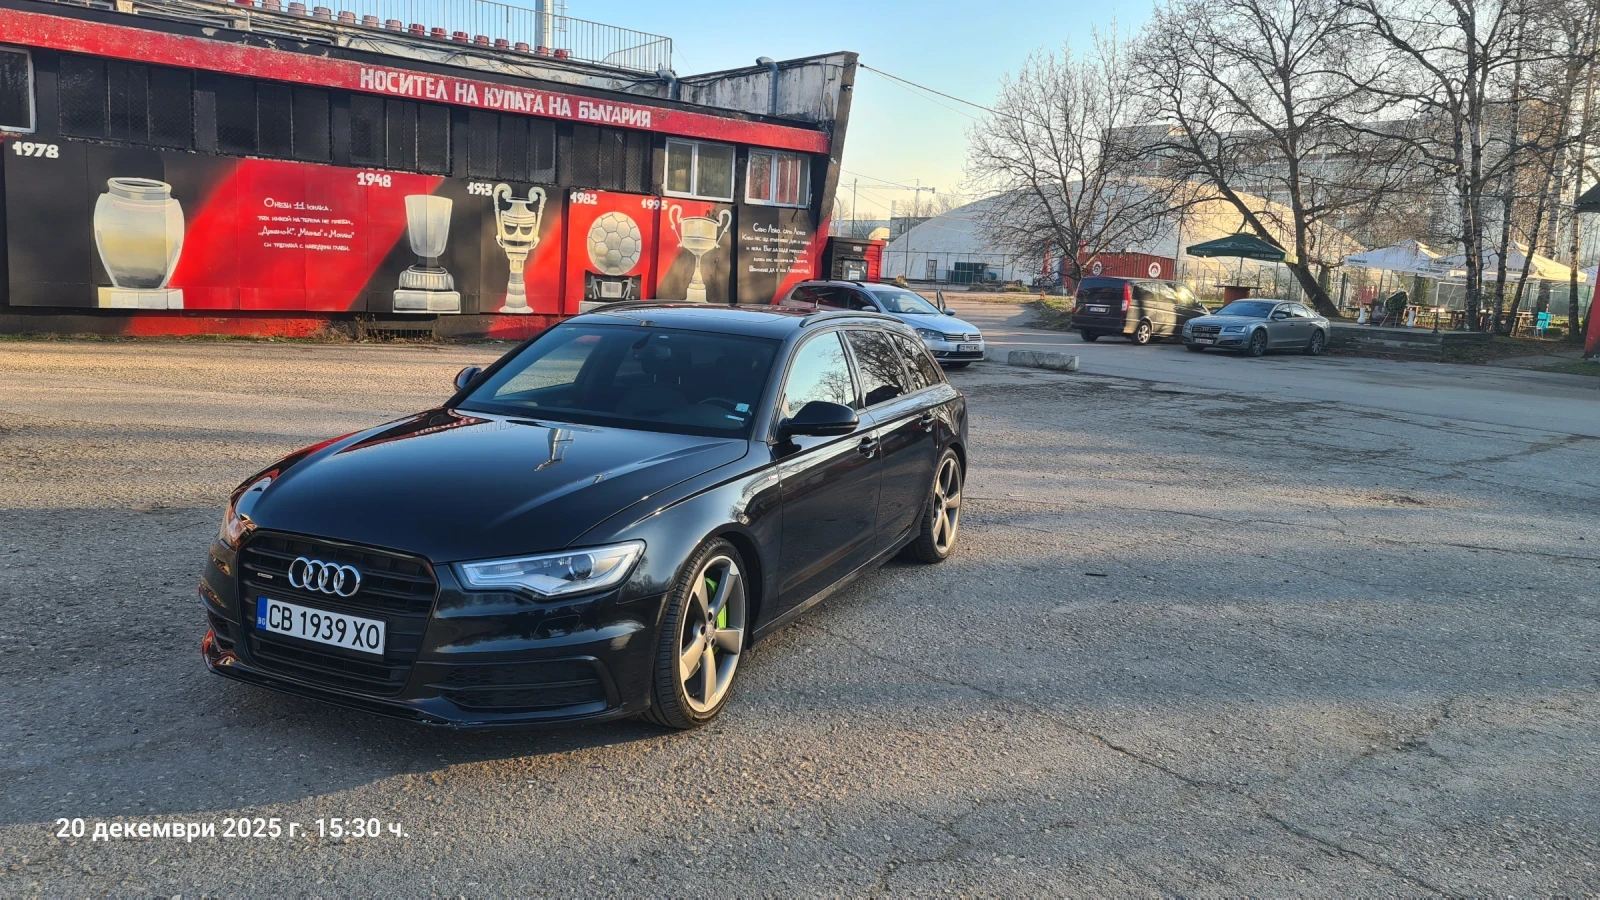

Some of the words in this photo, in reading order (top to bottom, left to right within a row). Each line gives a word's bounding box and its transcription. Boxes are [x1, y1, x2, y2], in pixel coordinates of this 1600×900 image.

[360, 67, 448, 100] НОСИТЕЛ
[455, 82, 478, 105] НА
[484, 87, 545, 114] КУПАТА
[549, 95, 571, 117] НА
[578, 101, 651, 128] БЪЛГАРИЯ
[12, 141, 59, 158] 1978
[357, 172, 391, 187] 1948
[570, 191, 597, 205] 1982
[641, 198, 668, 210] 1995
[257, 616, 266, 626] BG
[269, 604, 292, 632] CB
[300, 611, 347, 643] 1939
[351, 621, 379, 649] XO
